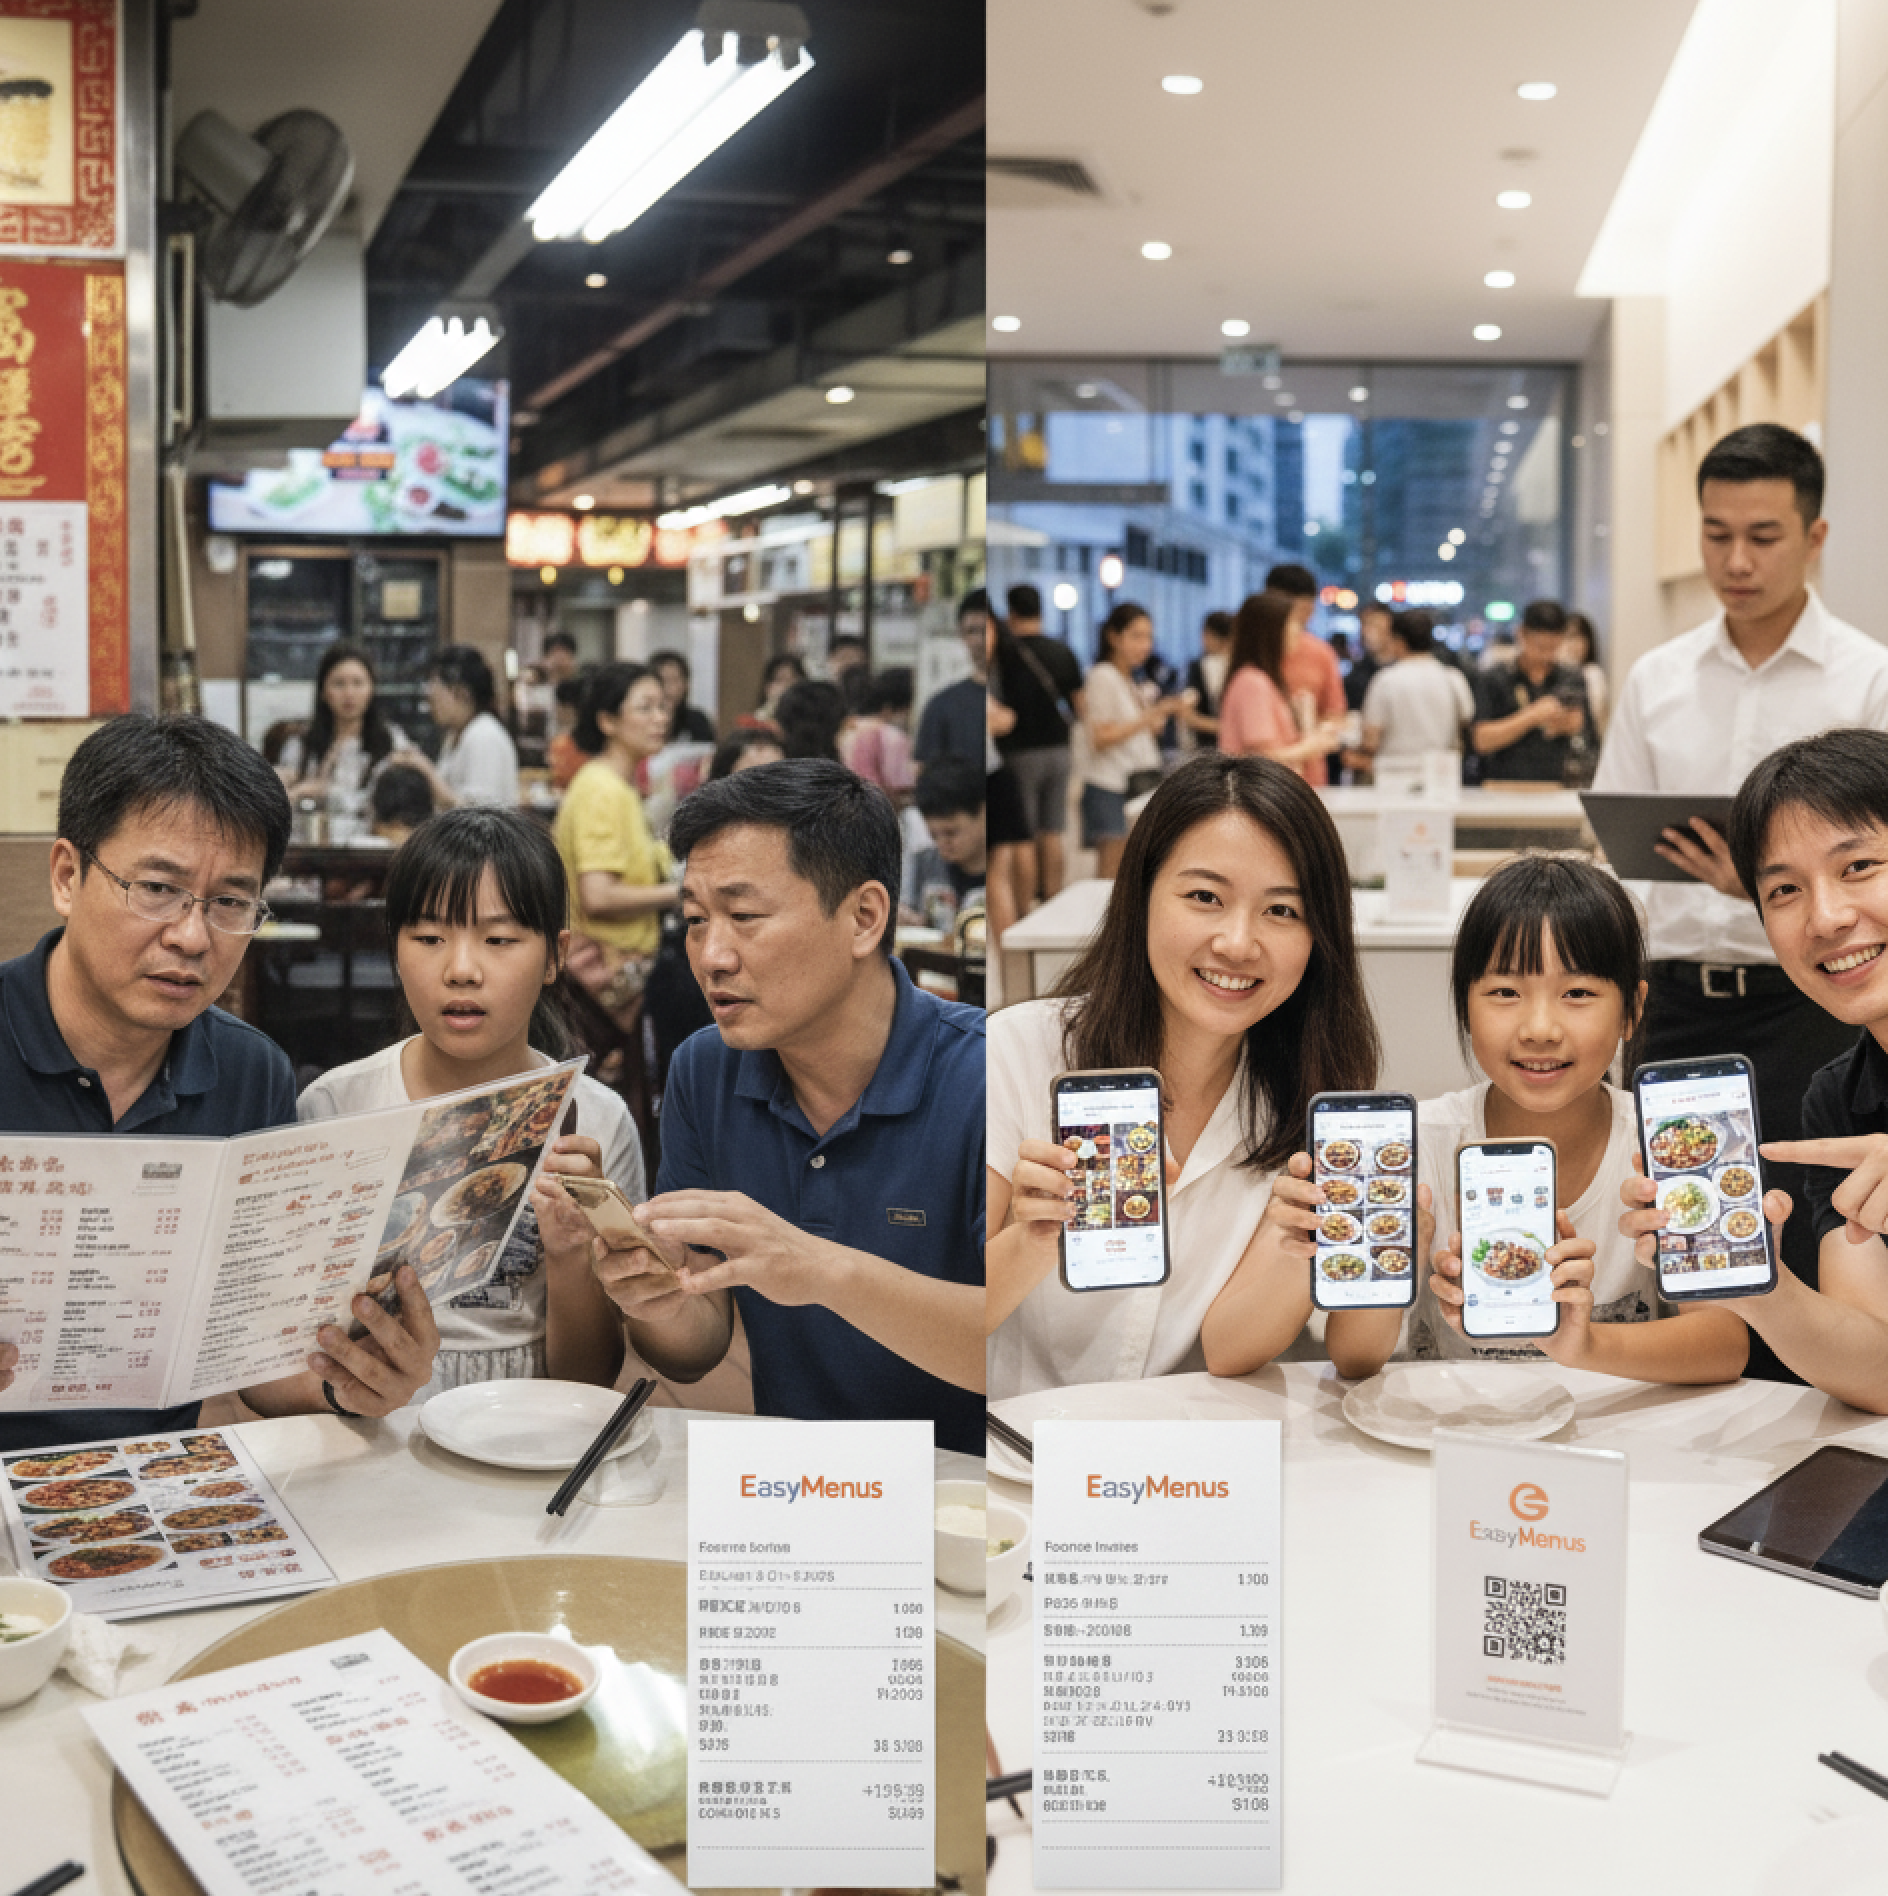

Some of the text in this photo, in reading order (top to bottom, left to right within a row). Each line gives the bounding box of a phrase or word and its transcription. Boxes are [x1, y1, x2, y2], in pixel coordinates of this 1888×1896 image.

[740, 1474, 883, 1504] EasyMenus
[1086, 1474, 1230, 1504] EasyMenus
[1470, 1520, 1587, 1552] EasyMenus
